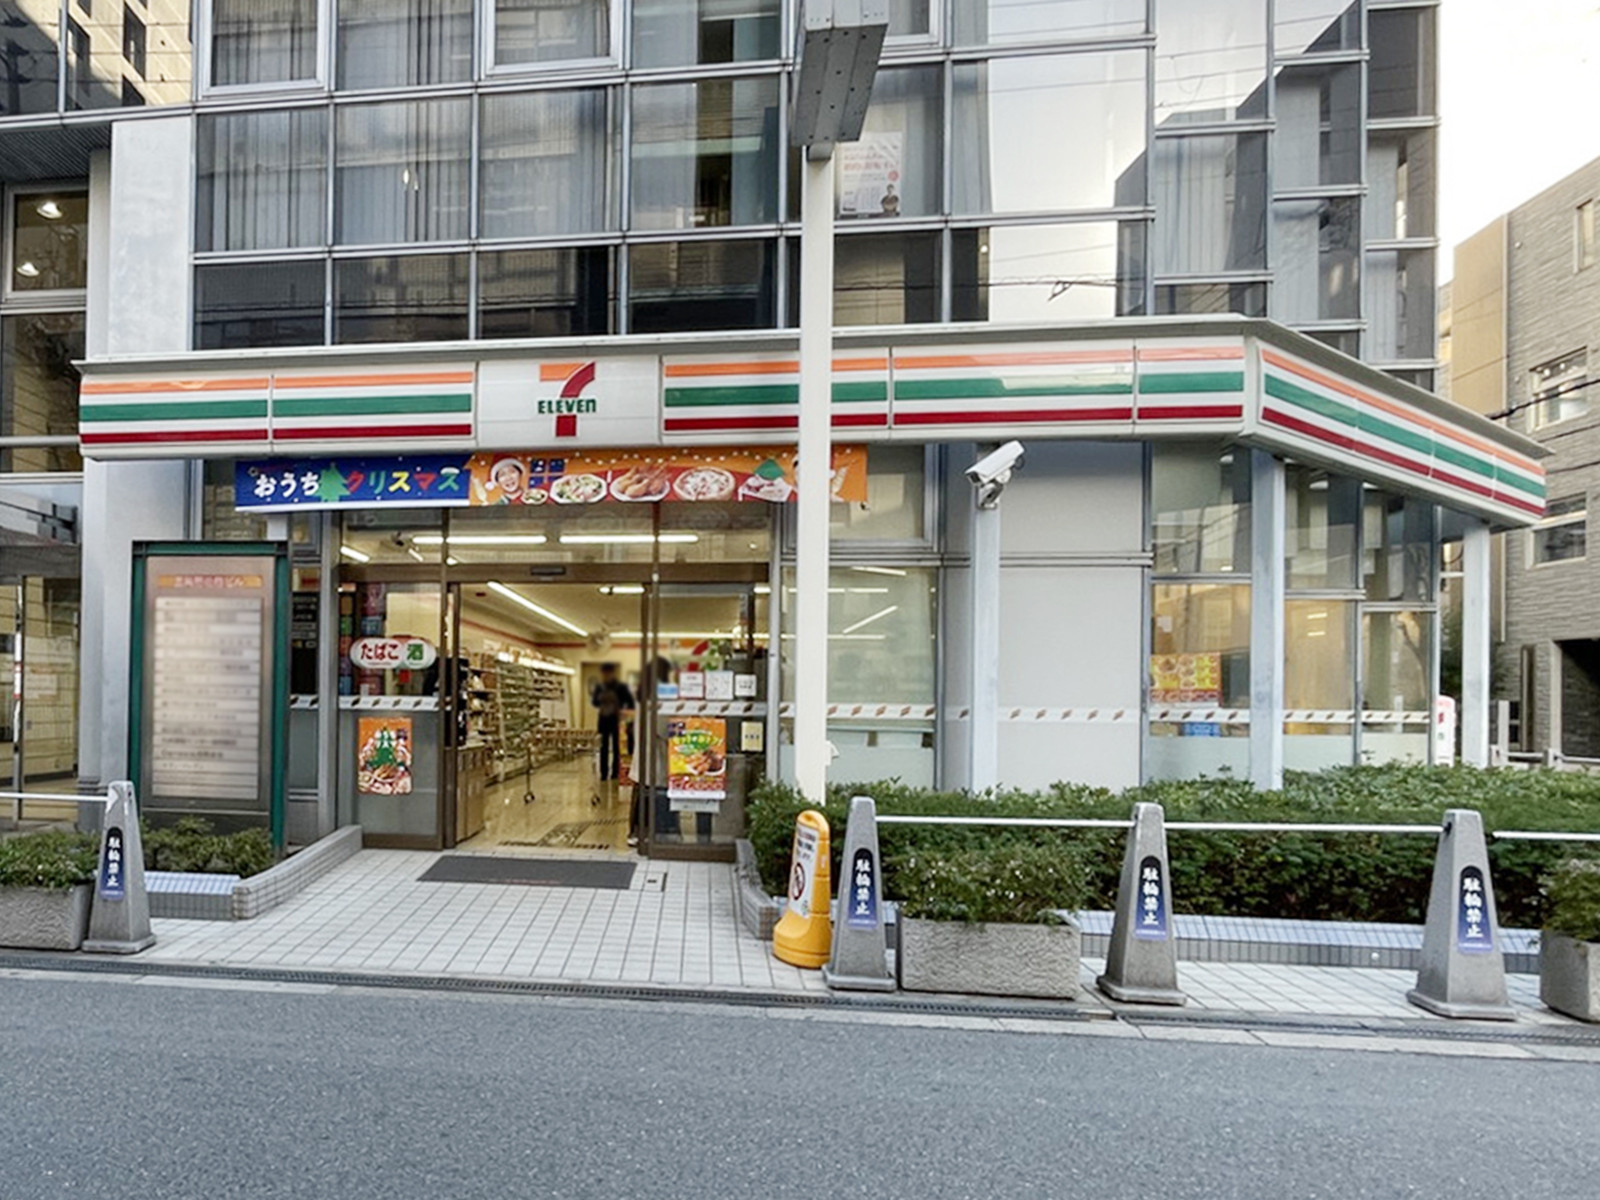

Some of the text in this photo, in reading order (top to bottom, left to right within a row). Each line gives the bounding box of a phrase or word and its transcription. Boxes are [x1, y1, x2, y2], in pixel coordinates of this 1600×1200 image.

[254, 467, 460, 498] おうち クリスマス
[360, 642, 424, 661] たばこ 酒
[107, 836, 121, 888] 駐輪禁止
[855, 858, 872, 916] 駐輪禁止
[1142, 867, 1159, 926] 駐輪禁止
[1463, 877, 1484, 938] 駐輪禁止
